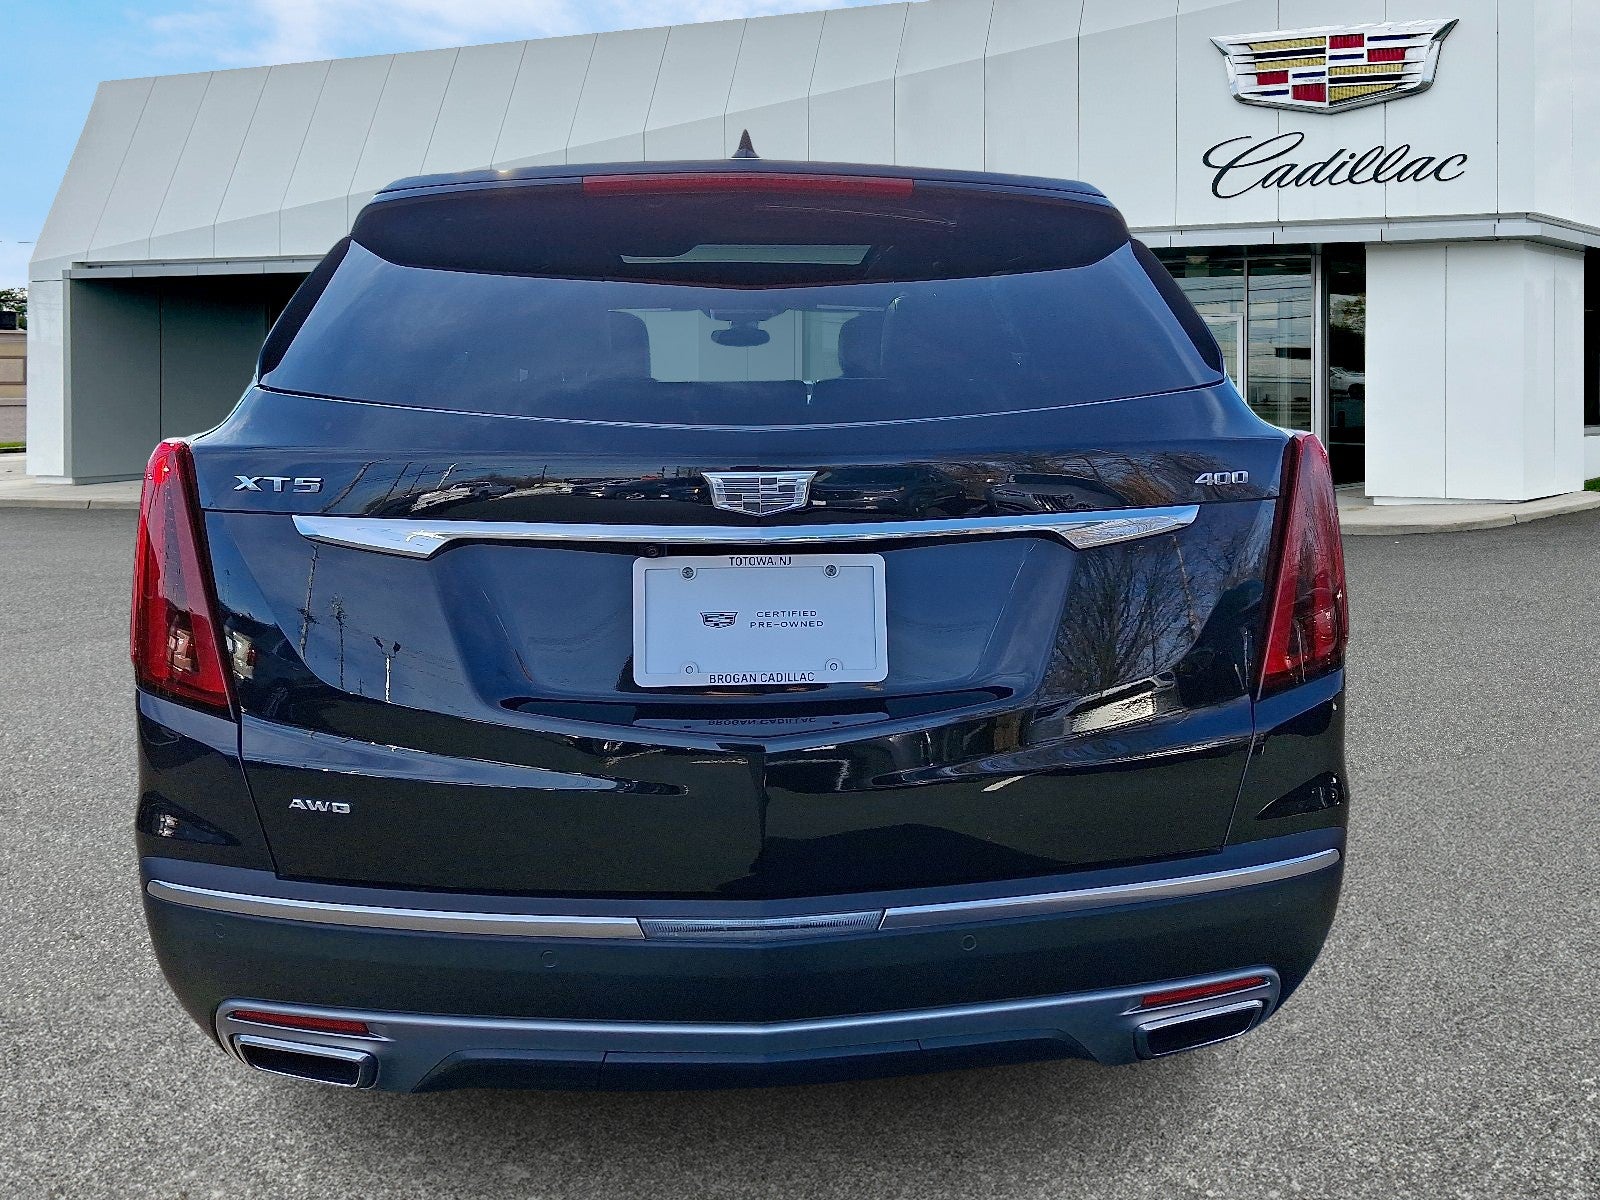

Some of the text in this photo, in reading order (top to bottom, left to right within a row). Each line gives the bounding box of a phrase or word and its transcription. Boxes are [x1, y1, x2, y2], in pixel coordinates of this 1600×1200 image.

[1202, 131, 1468, 199] Cadillac
[233, 475, 322, 493] XT5
[1194, 470, 1249, 486] 400
[779, 556, 792, 566] NJ
[756, 610, 817, 618] CERTIFIED
[749, 620, 824, 628] PRE-OWNED
[709, 671, 816, 684] BROGAN CADILLAC
